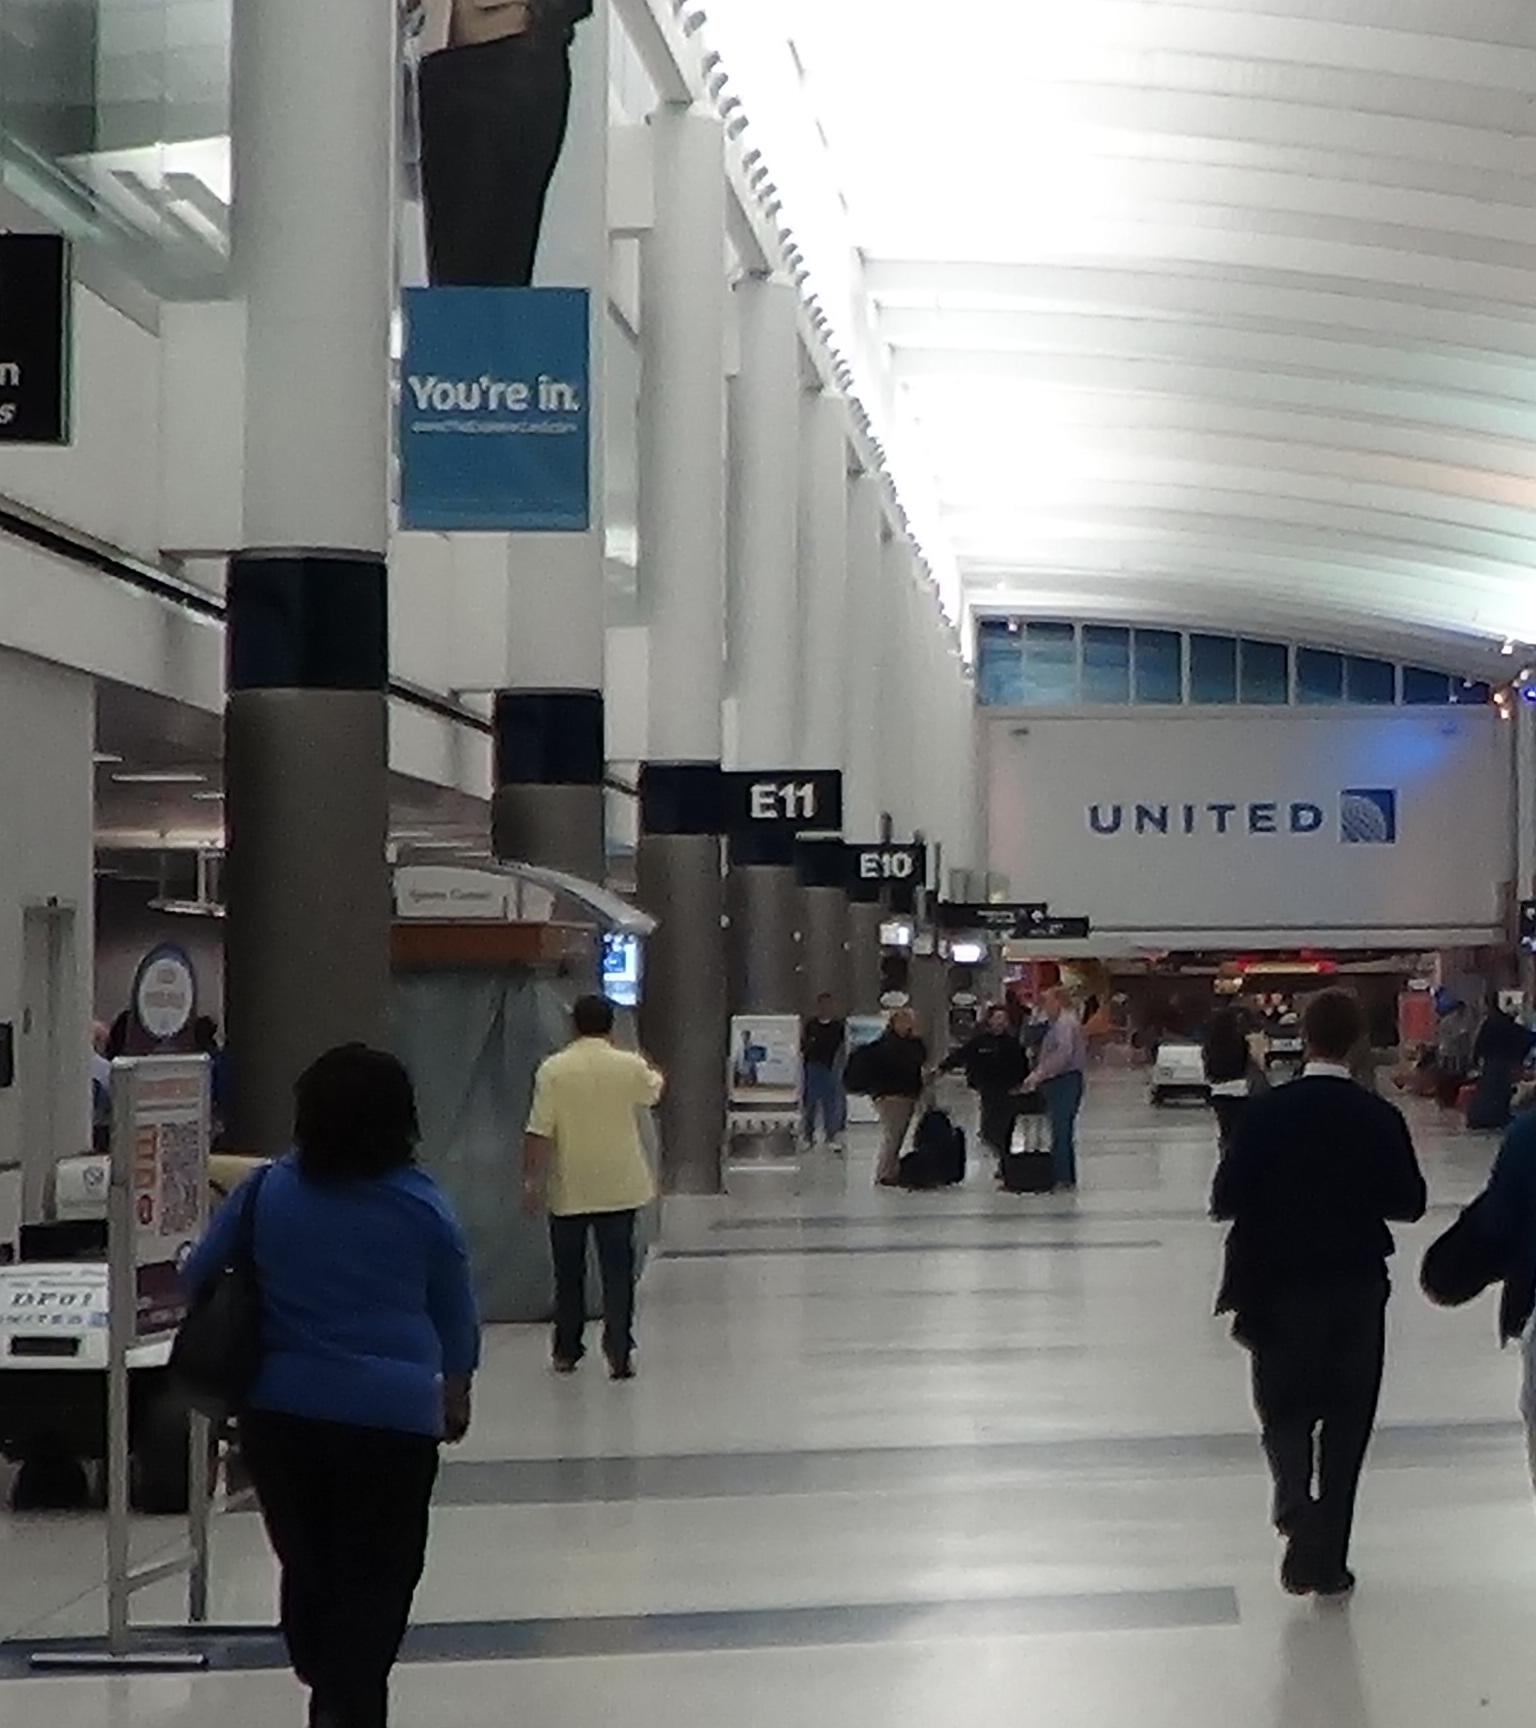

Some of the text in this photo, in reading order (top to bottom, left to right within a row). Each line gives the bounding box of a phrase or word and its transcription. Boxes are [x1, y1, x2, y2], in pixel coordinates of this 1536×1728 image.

[407, 374, 581, 412] You're in.
[749, 783, 816, 819] E11
[1089, 803, 1324, 835] UNITED
[859, 852, 913, 879] E10
